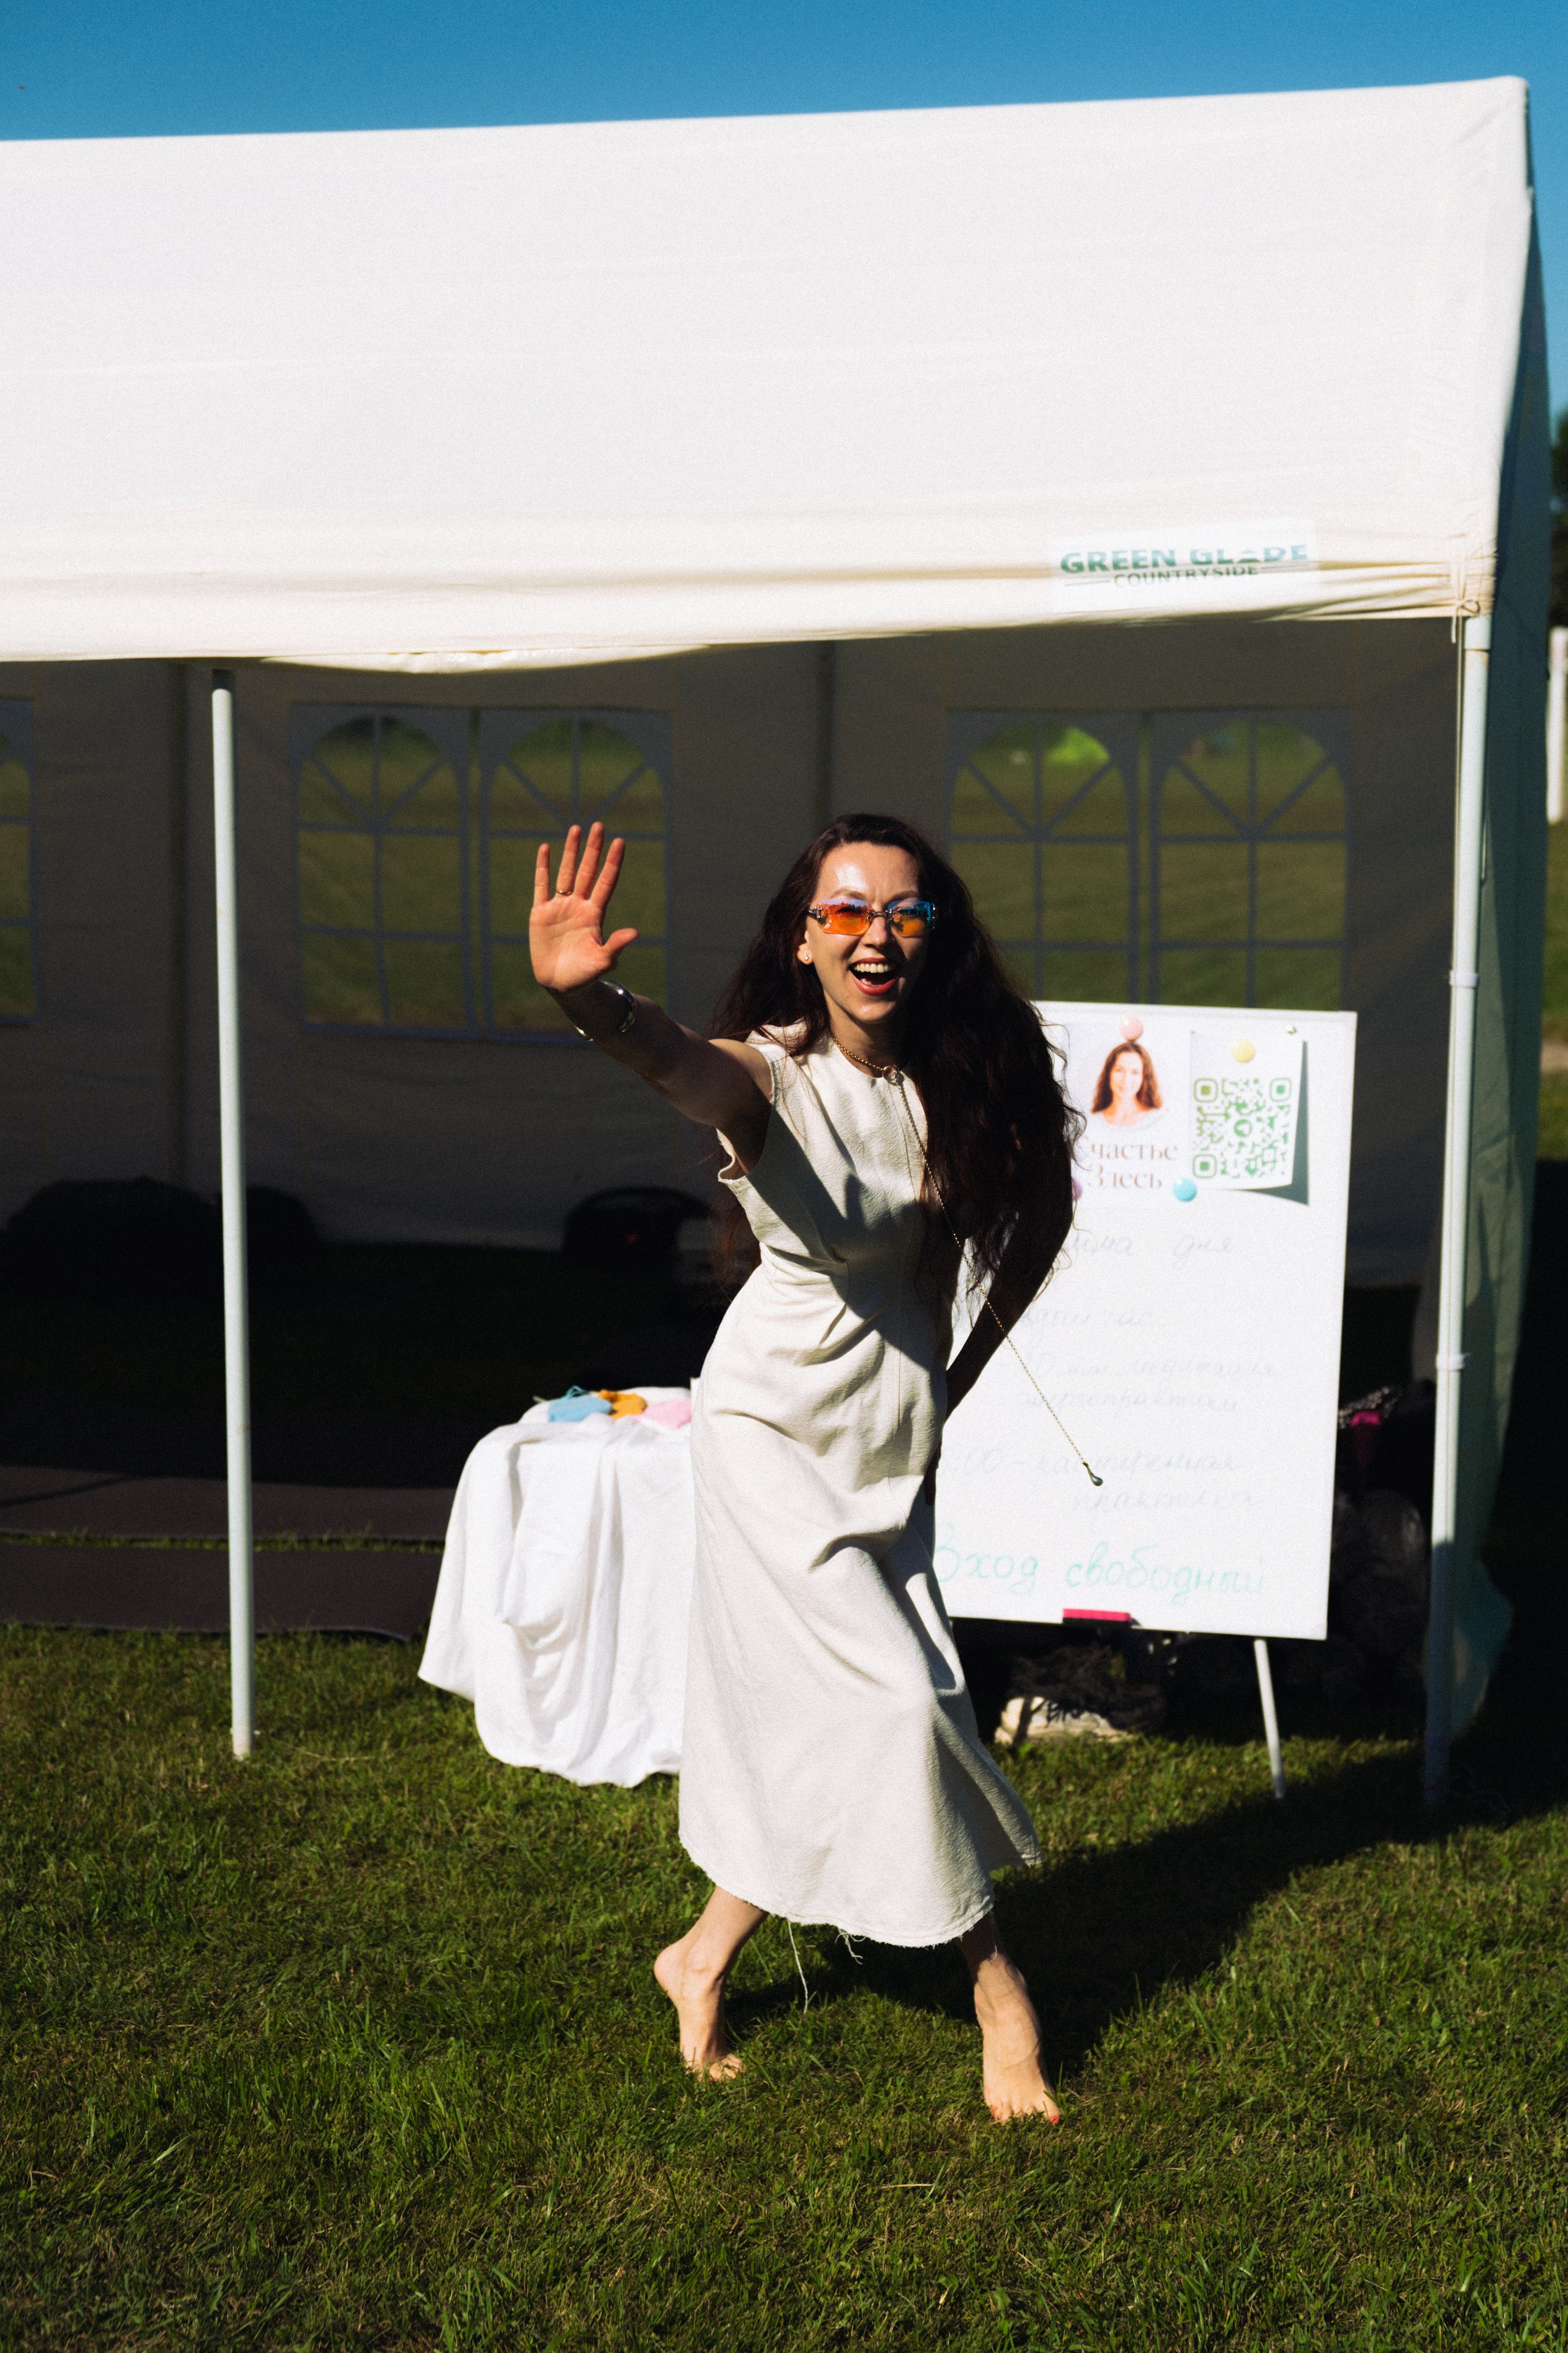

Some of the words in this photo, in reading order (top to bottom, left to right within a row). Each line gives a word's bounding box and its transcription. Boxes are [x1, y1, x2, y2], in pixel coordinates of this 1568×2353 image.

[1060, 548, 1177, 574] GREEN
[1114, 564, 1259, 588] COUNTRYSIDE
[1079, 1143, 1178, 1161] частье
